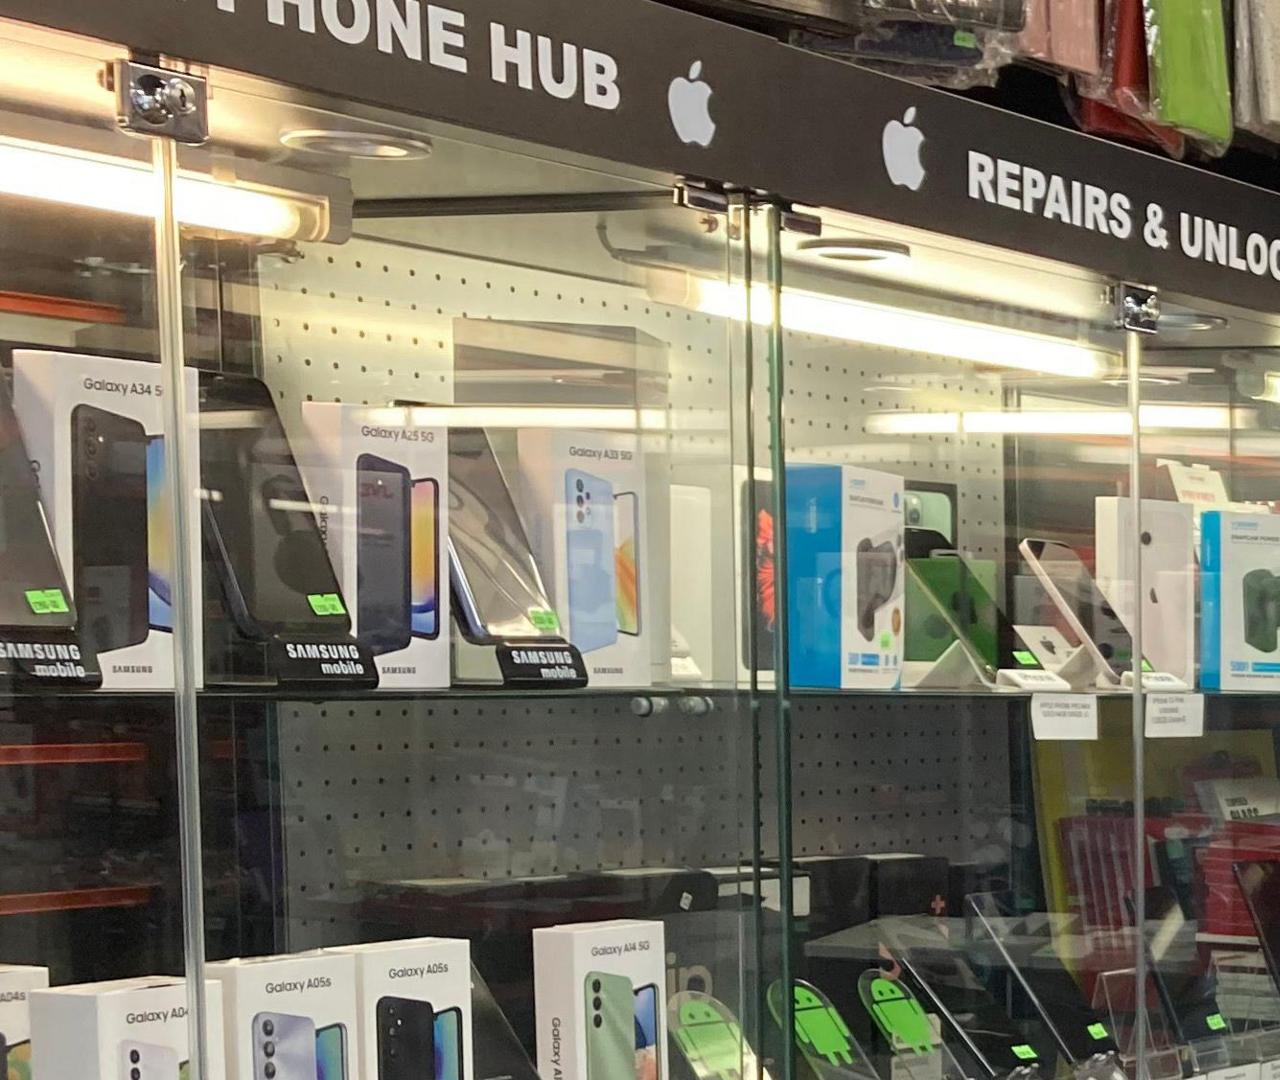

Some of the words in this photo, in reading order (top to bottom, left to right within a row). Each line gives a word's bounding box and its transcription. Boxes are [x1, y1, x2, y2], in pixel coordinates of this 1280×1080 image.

[217, 0, 468, 73] HONE
[490, 22, 620, 110] HUB
[968, 150, 1131, 239] REPAIRS
[1143, 202, 1168, 249] &
[83, 377, 129, 397] Galaxy
[130, 380, 152, 396] A34
[361, 425, 400, 443] Galaxy
[401, 430, 420, 442] A25
[421, 431, 434, 442] 5G
[569, 446, 602, 460] Galaxy
[619, 451, 633, 461] 5G
[0, 642, 81, 660] SAMSUNG
[287, 643, 359, 660] SAMSUNG
[511, 650, 572, 665] SAMSUNG
[34, 663, 86, 678] mobile
[112, 665, 153, 674] SAMSUNG
[321, 660, 365, 675] mobile
[382, 666, 416, 675] SAMSUNG
[541, 666, 577, 679] mobile
[593, 667, 624, 675] SAMSUNG
[592, 943, 622, 957] Galaxy
[623, 942, 638, 954] A14
[639, 940, 651, 952] 5G
[388, 965, 424, 980] Galaxy
[426, 963, 449, 975] A05s
[265, 980, 304, 995] Galaxy
[306, 976, 332, 989] A05s
[126, 1010, 169, 1025] Galaxy
[550, 1016, 563, 1065] Galaxy
